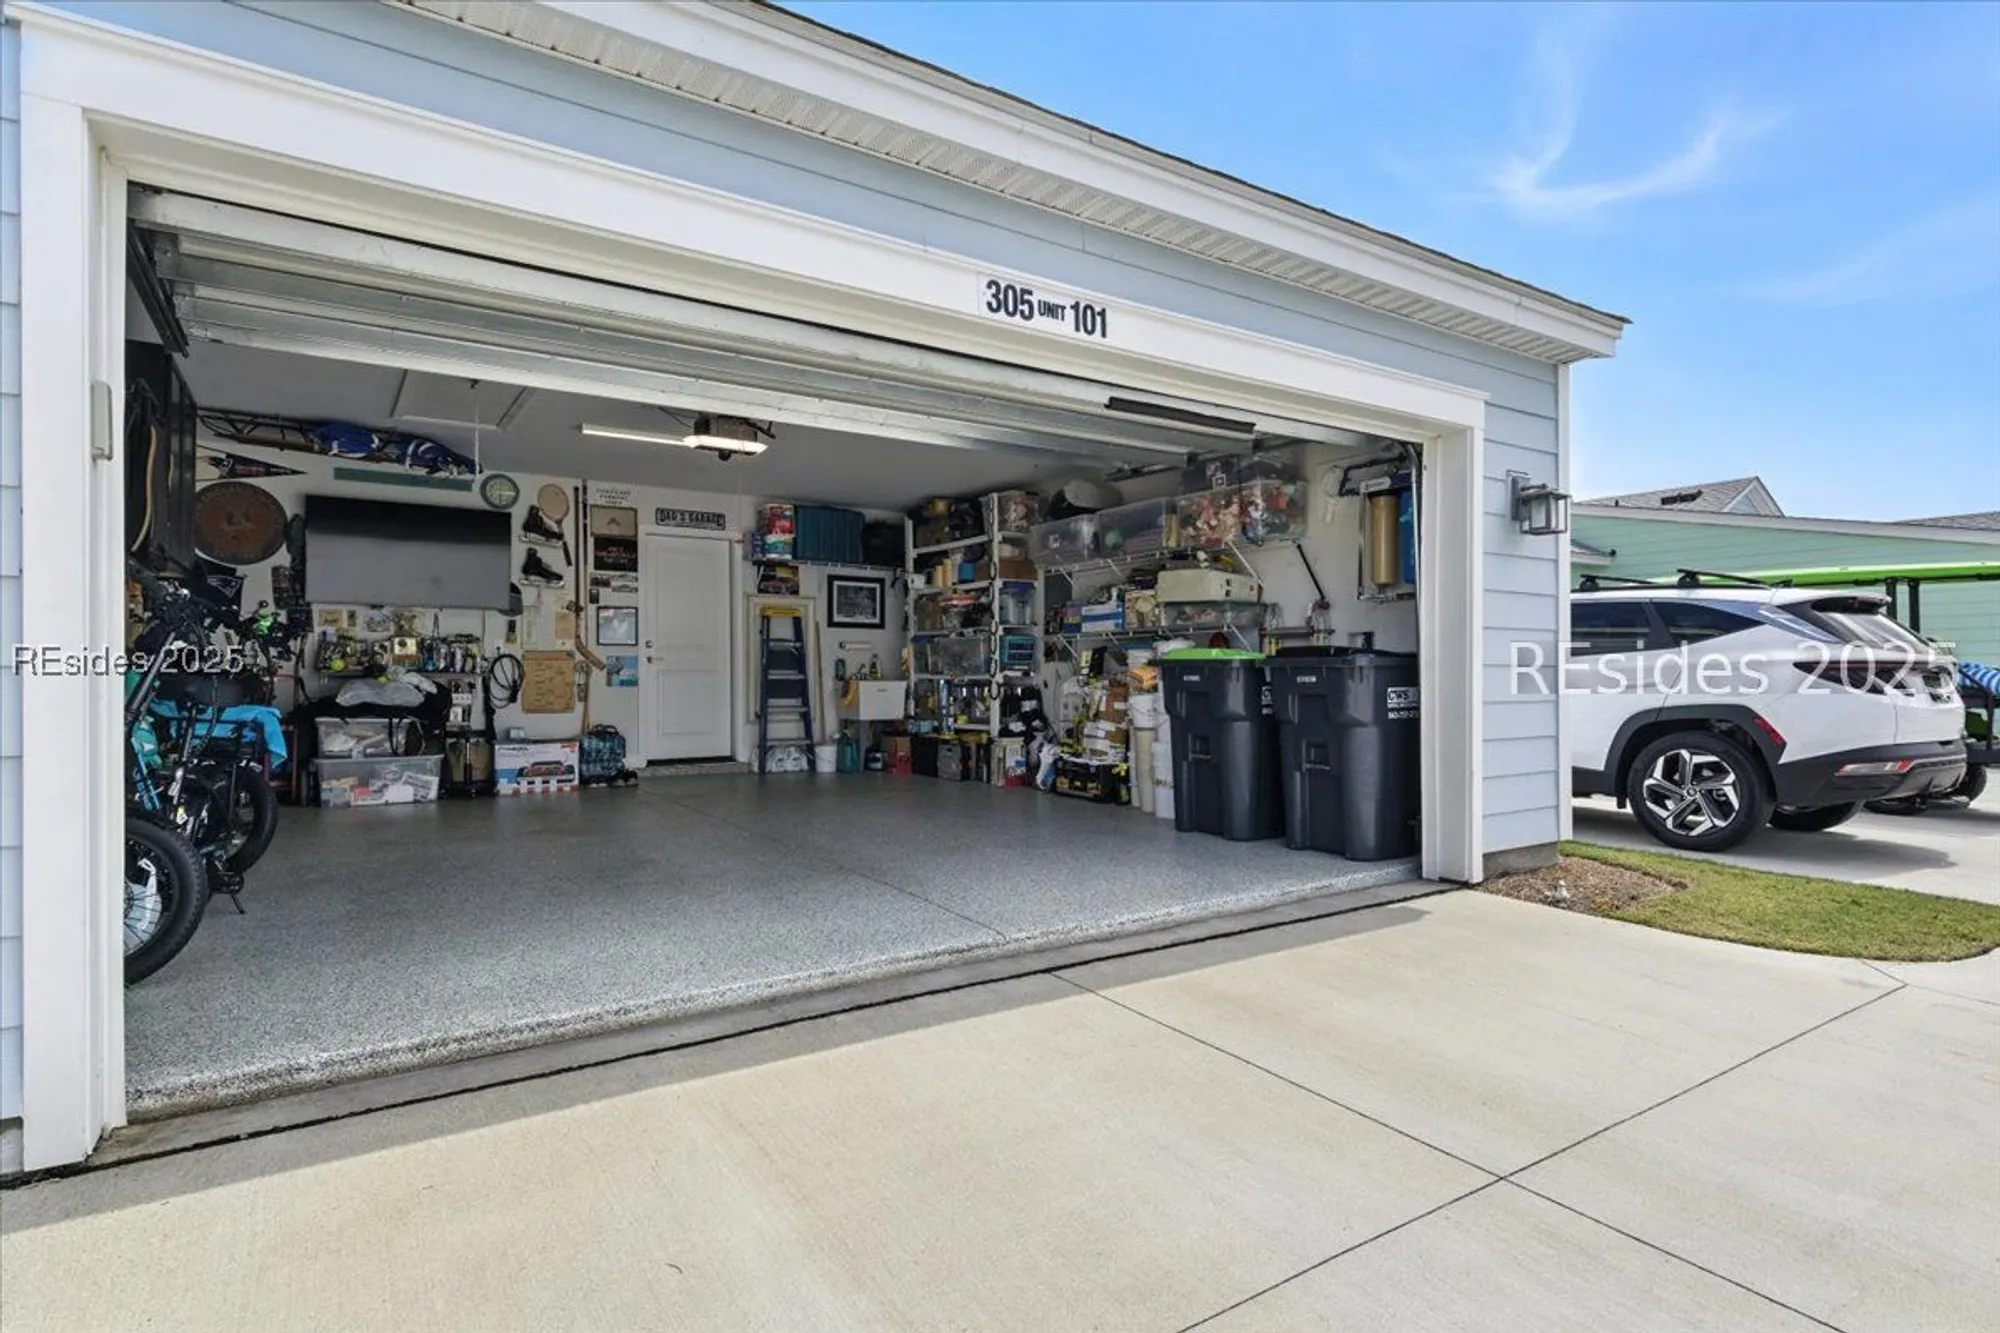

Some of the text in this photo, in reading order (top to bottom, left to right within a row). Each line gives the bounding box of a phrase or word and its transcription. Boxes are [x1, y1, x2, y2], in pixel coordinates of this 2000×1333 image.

[986, 279, 1107, 338] 305 UNIT 101
